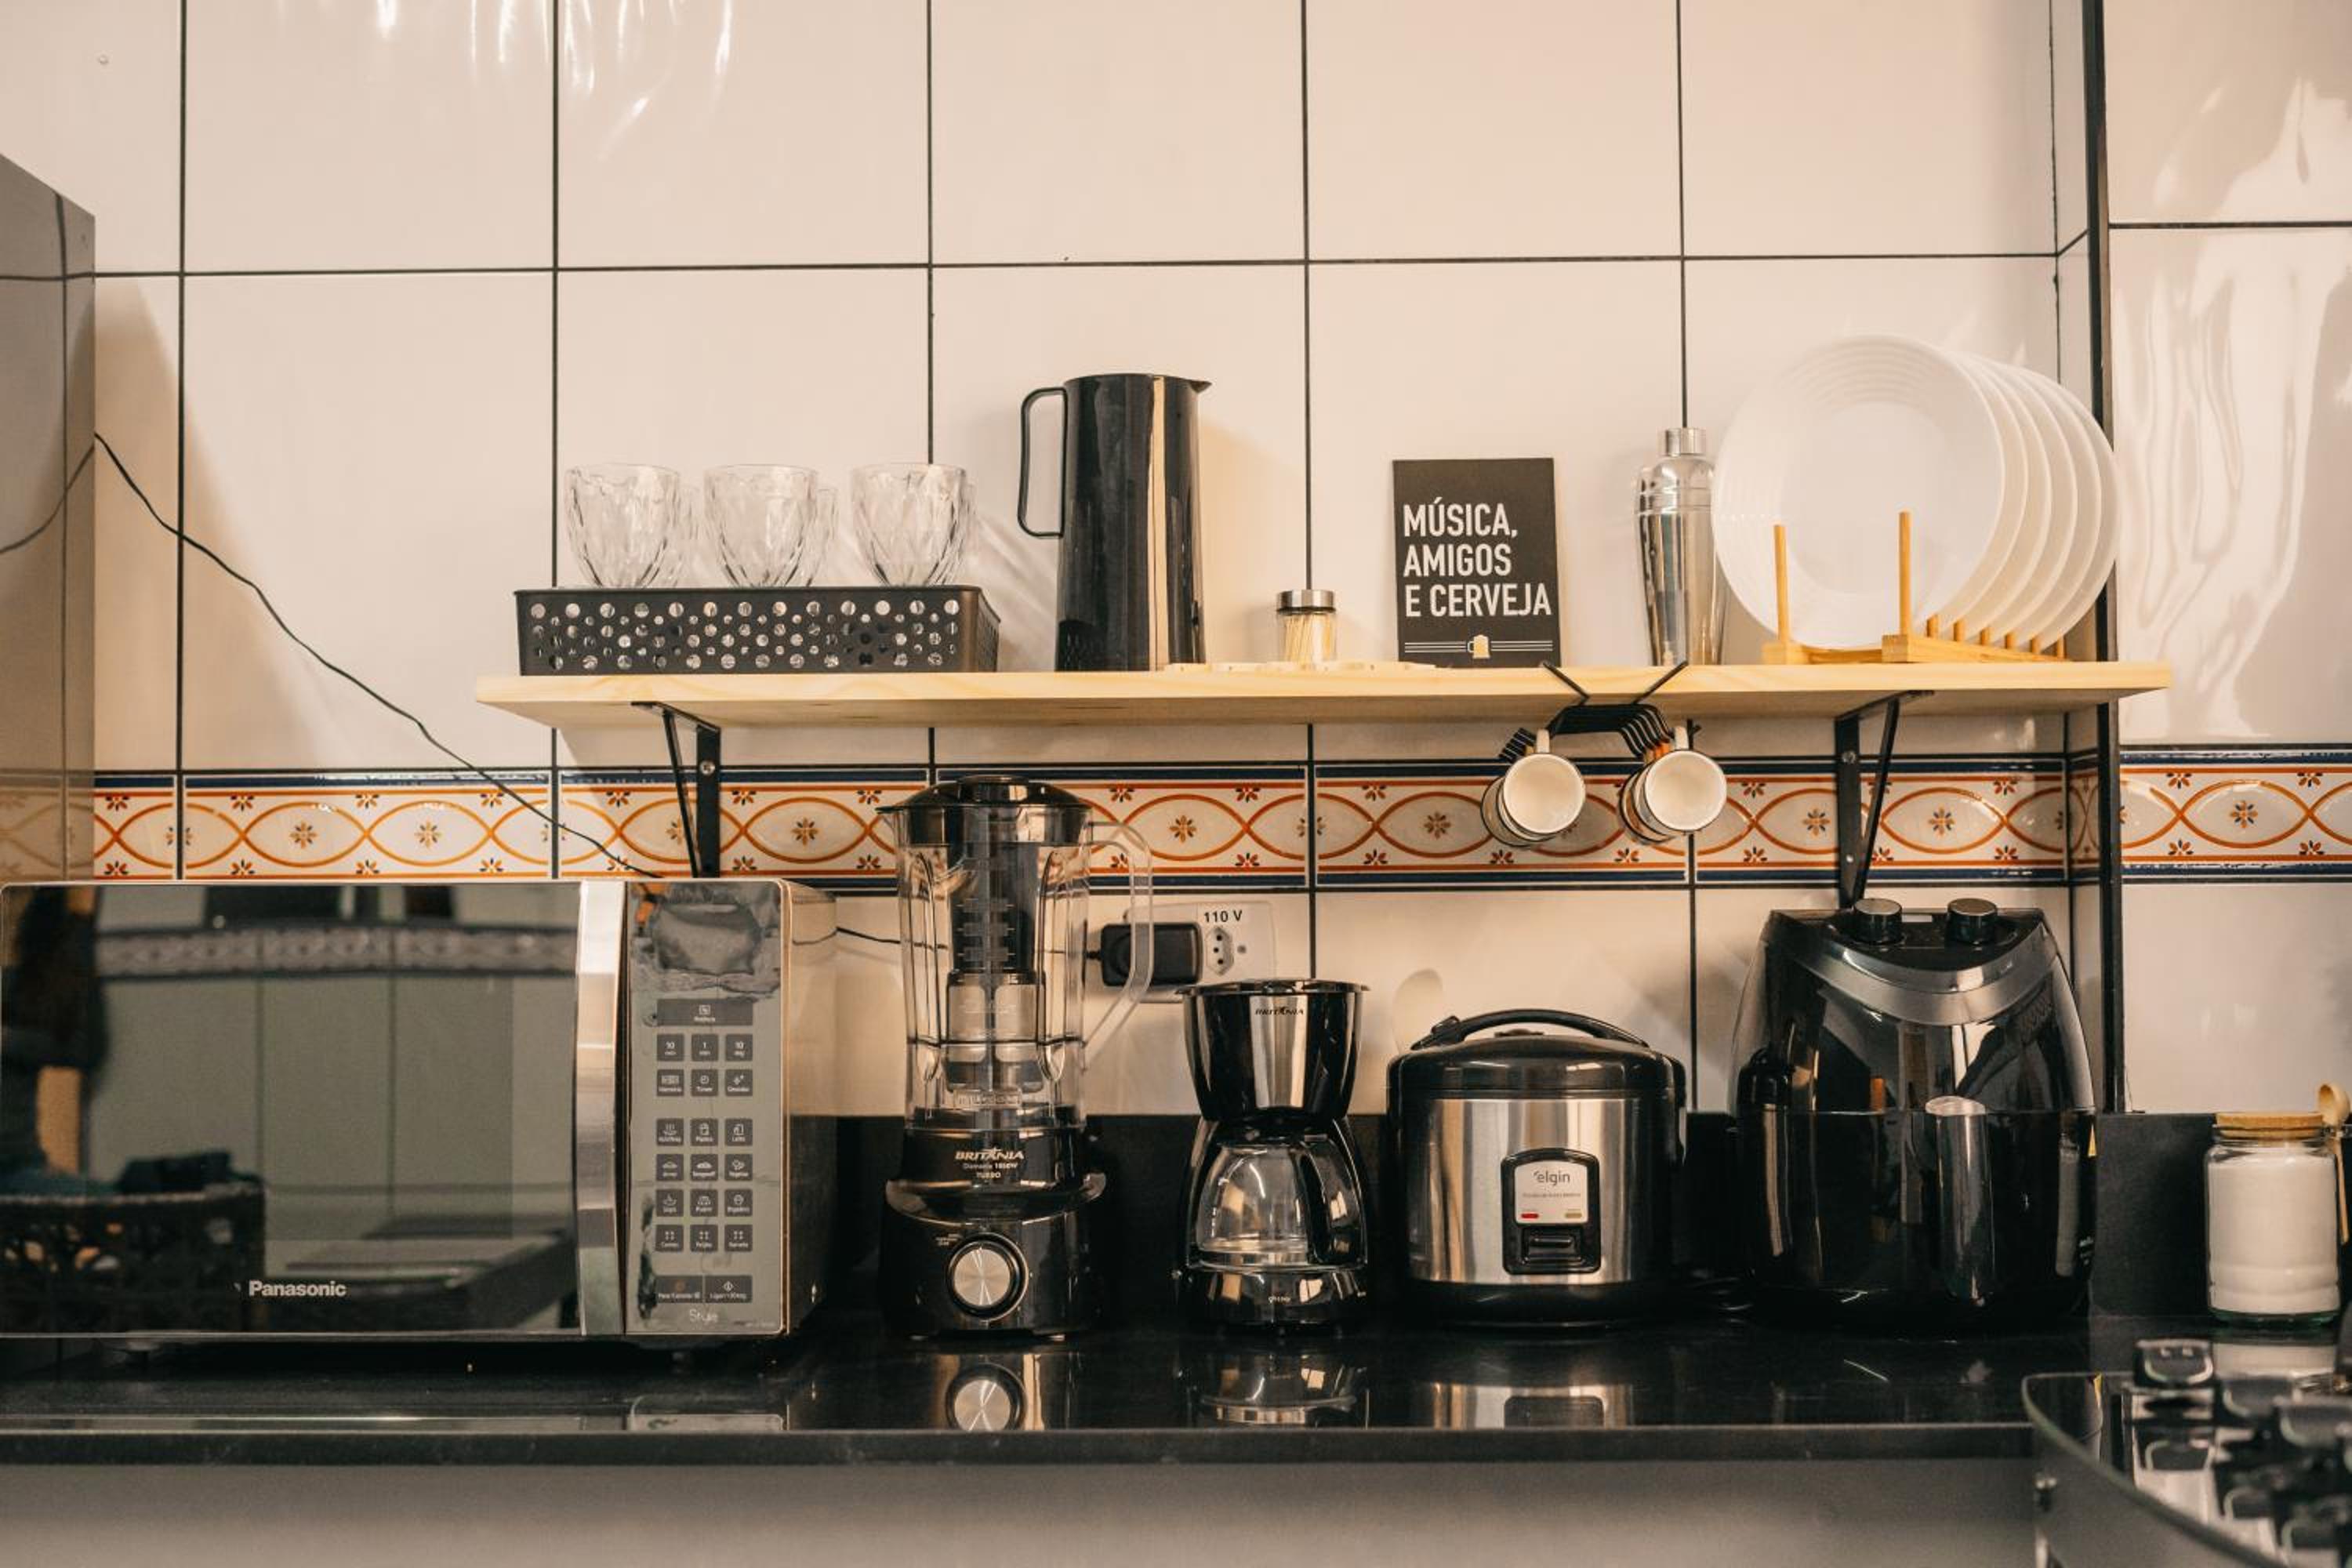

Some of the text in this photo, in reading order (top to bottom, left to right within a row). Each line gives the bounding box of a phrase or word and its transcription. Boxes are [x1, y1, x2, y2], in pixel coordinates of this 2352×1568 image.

[1403, 497, 1518, 539] MÚSICA,
[1403, 543, 1512, 577] AMIGOS
[1406, 583, 1552, 617] E CERVEJA
[1203, 909, 1243, 923] 110 V
[1534, 1171, 1571, 1186] elgin
[249, 1279, 347, 1297] Panasonic
